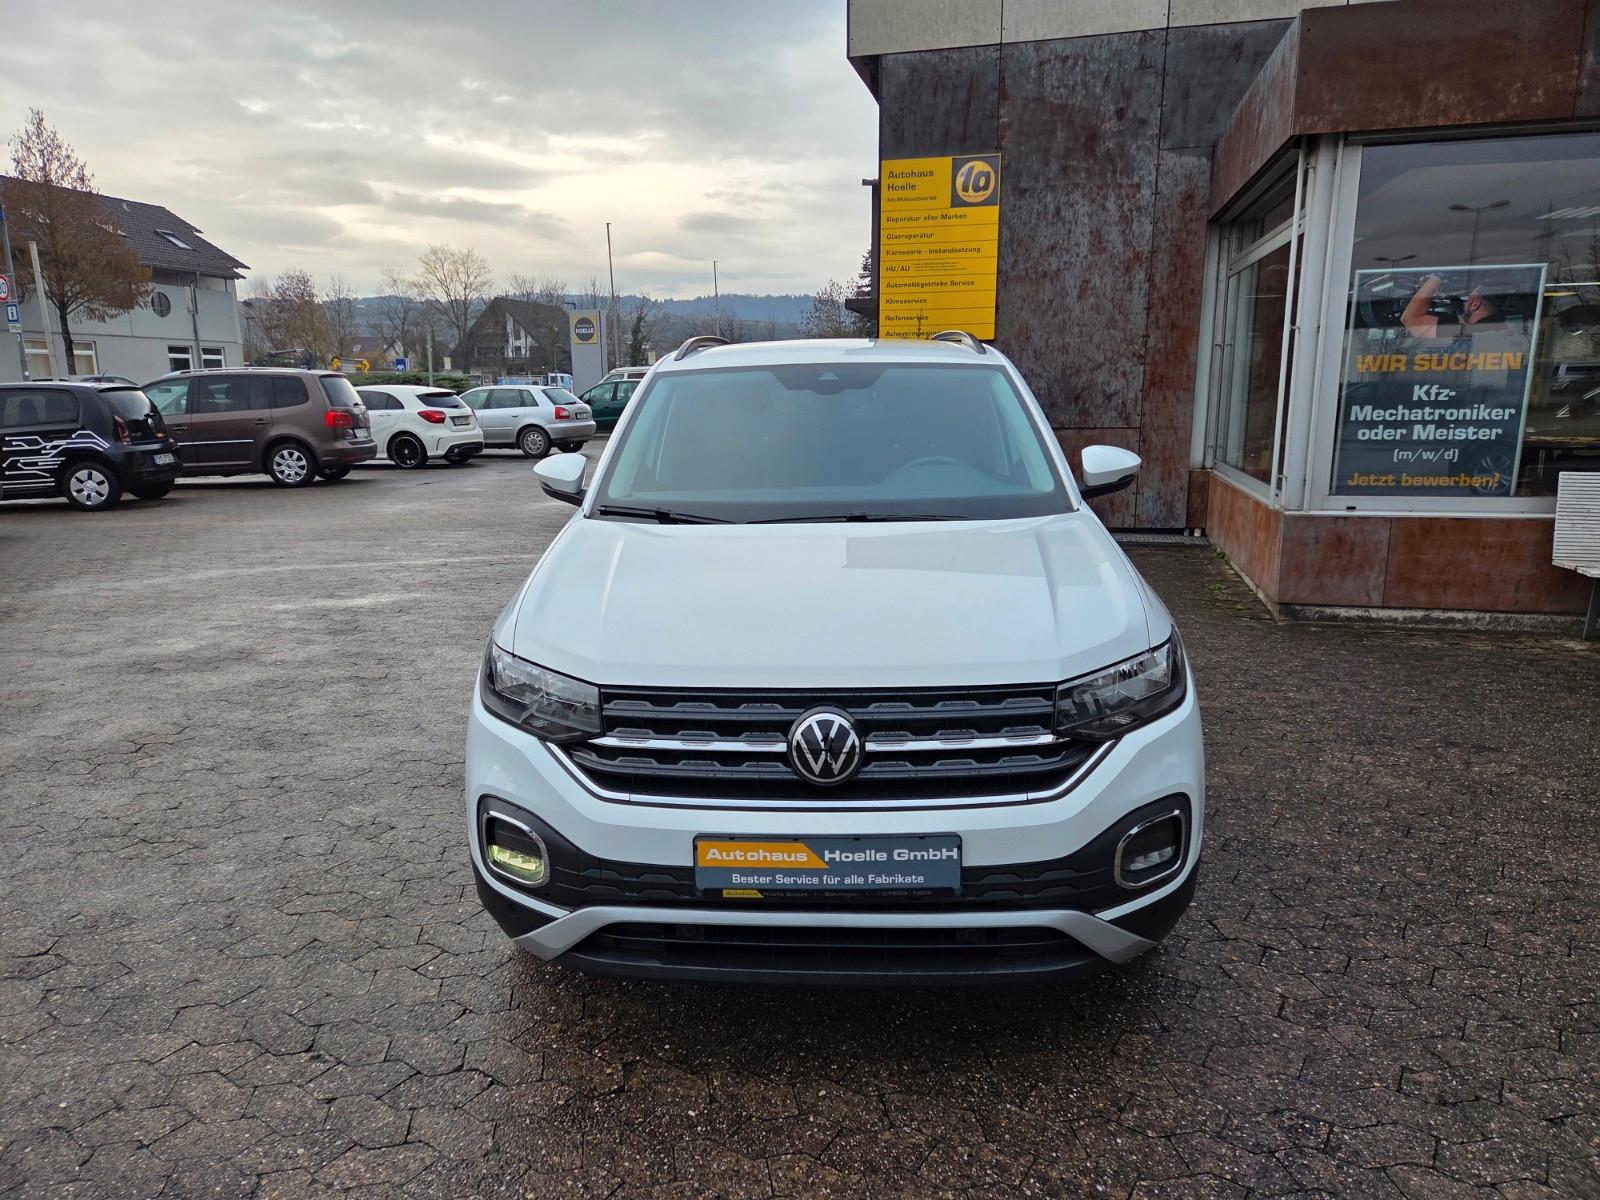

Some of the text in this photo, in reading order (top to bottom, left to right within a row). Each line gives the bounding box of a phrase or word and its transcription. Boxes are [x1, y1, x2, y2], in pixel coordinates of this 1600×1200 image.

[888, 169, 934, 179] Autohaus
[887, 182, 917, 191] Hoelle
[886, 232, 935, 240] Glasreparatur
[928, 246, 981, 255] Instandsetzung
[886, 264, 910, 273] HU/AU
[886, 279, 975, 289] Automatikgetriebe Service
[1356, 351, 1524, 373] WIR SUCHEN
[1412, 384, 1456, 401] Kfz-
[1350, 404, 1515, 422] Mechatroniker
[1357, 424, 1502, 441] oder Meister
[1348, 471, 1500, 487] Jetzt bewerben!
[705, 847, 959, 862] Autohaus Hoelle GmbH
[732, 873, 925, 885] Bester Service für alle Fabrikate
